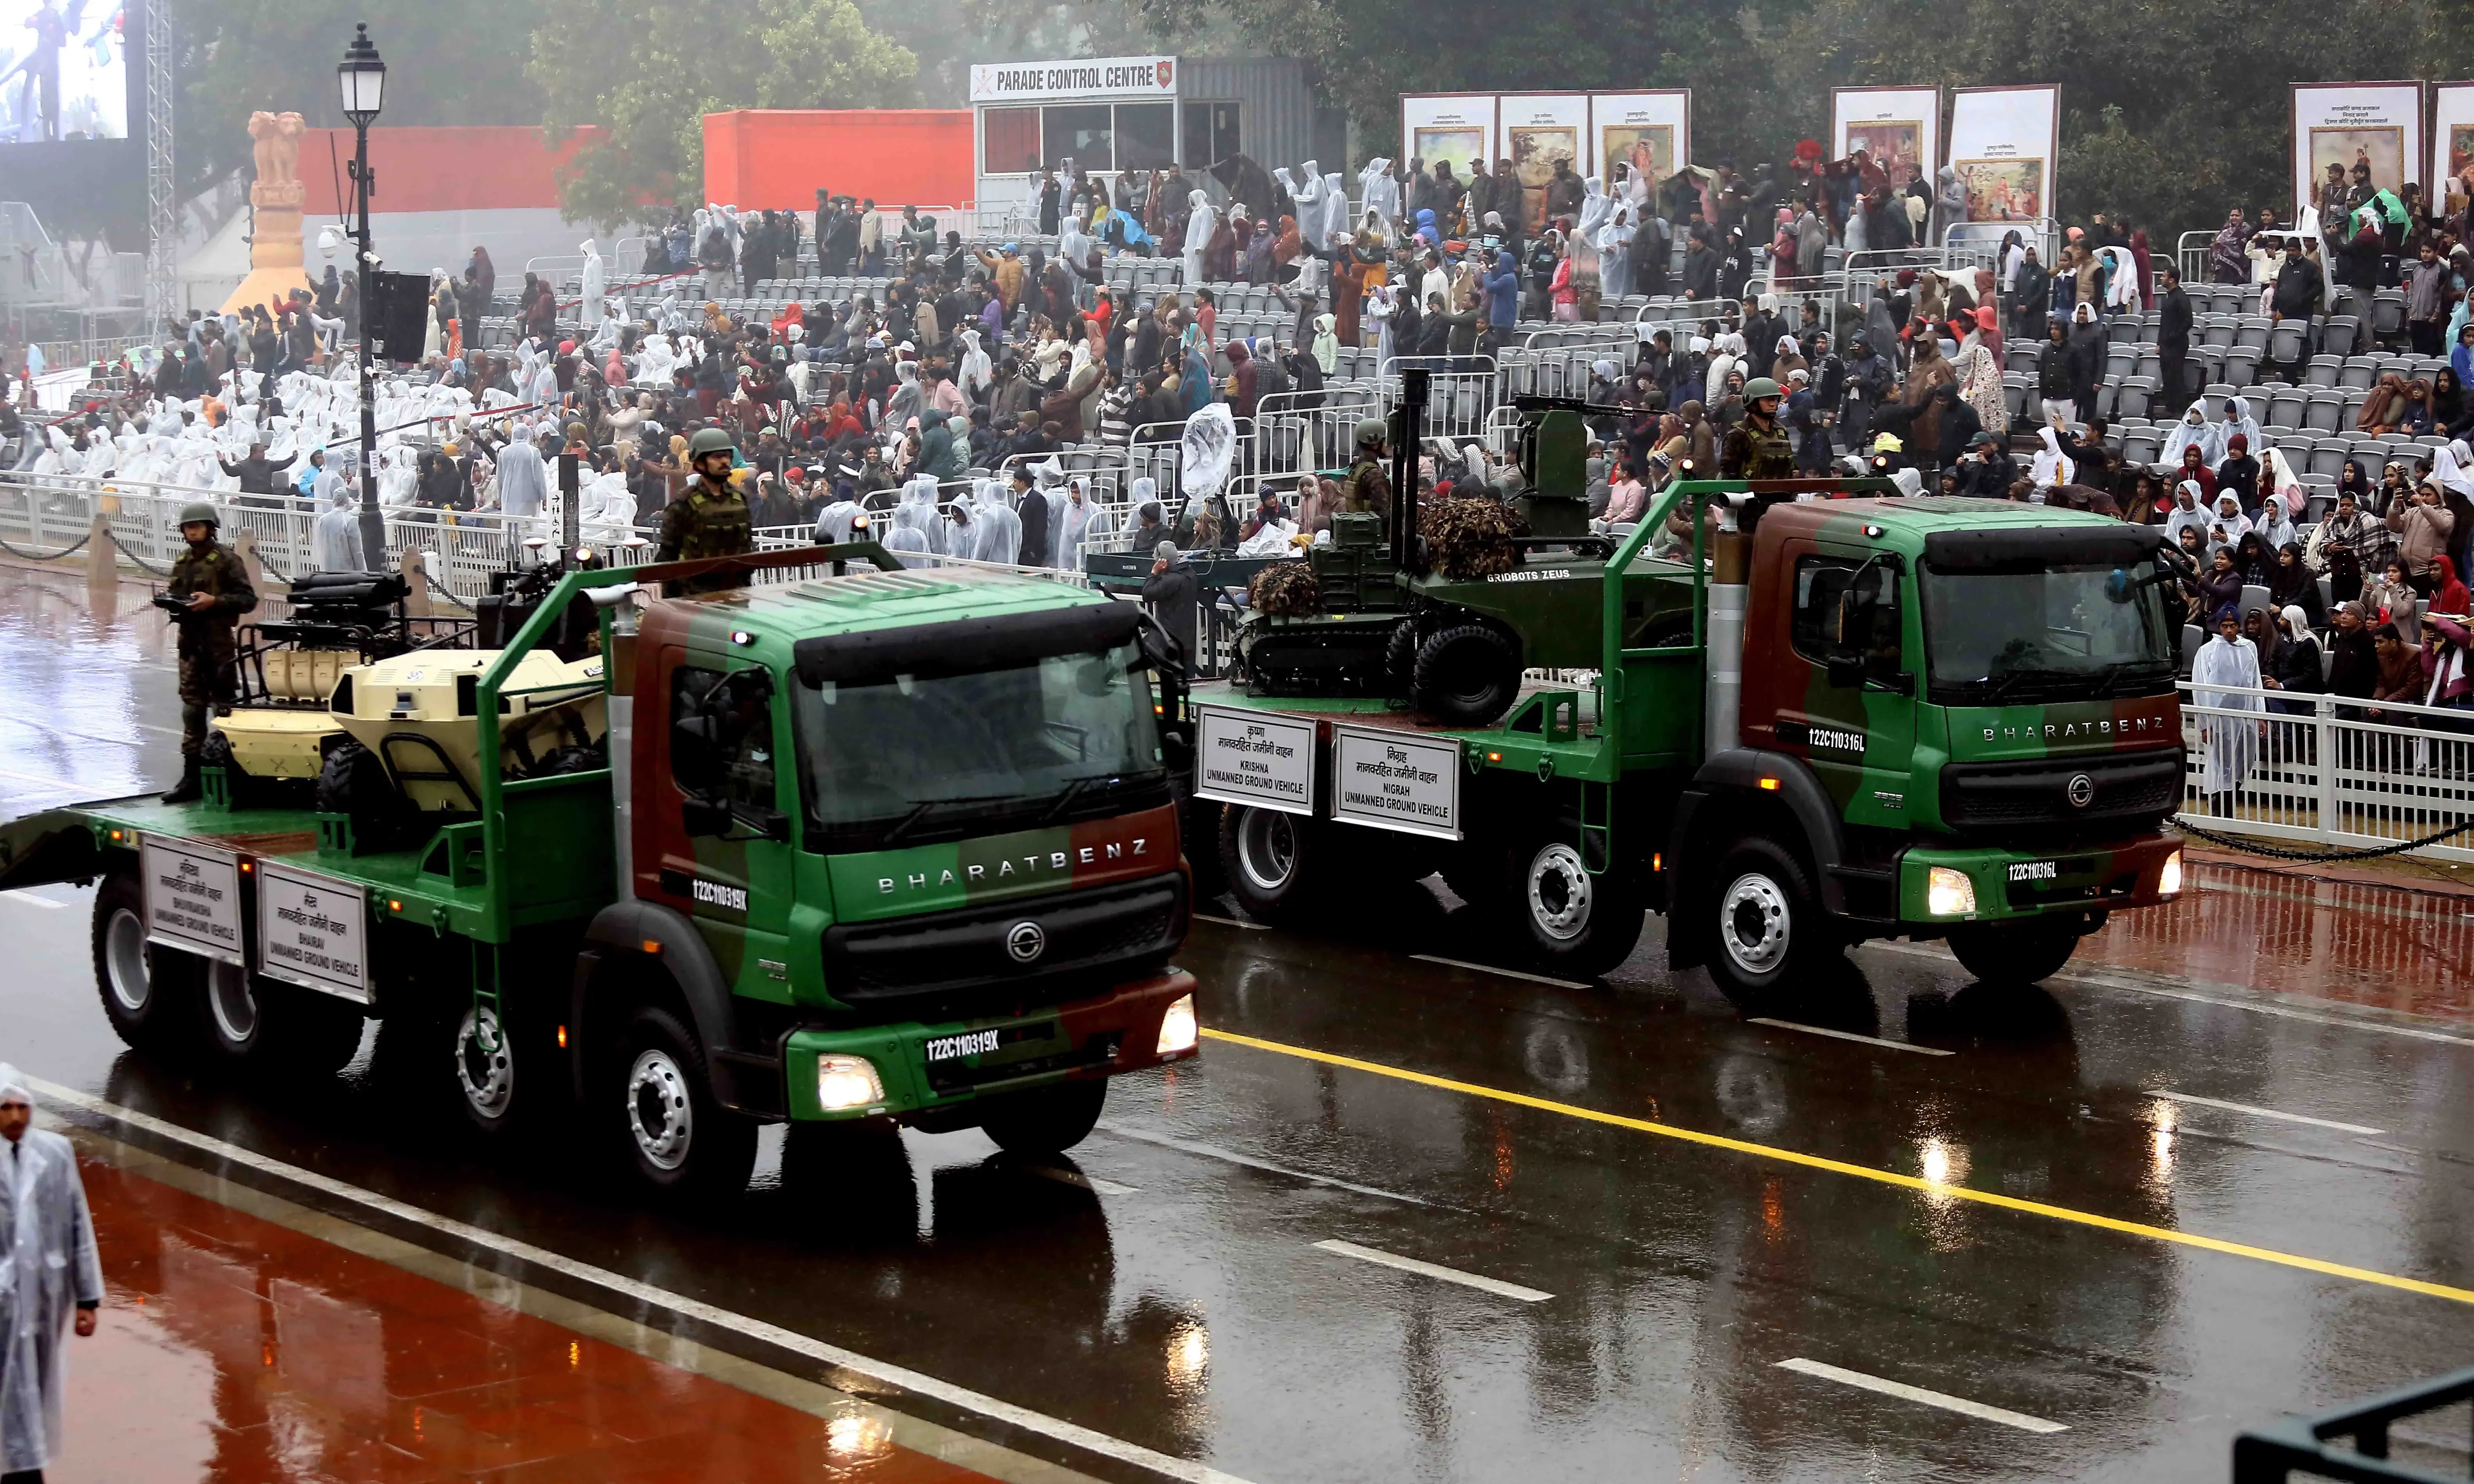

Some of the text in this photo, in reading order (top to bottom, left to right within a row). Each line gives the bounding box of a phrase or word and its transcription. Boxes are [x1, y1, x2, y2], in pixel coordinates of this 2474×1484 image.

[997, 65, 1153, 91] PARADE CONTROL CENTRE
[1487, 570, 1570, 583] GRIDBOTS ZEUS
[1247, 725, 1265, 740] कृष्णा
[1984, 717, 2163, 741] BHARATBENZ
[1218, 737, 1293, 758] मानवरहित जमीनी वाहन
[1814, 729, 1864, 752] 22C110316L
[1387, 747, 1407, 763] निग्रह
[1240, 760, 1268, 774] KRISHNA
[1356, 762, 1437, 784] मानवरहित जमीनी वाहन
[1207, 769, 1303, 794] UNMANNED GROUND VEHICLE
[1383, 783, 1410, 797] NIGRAH
[1345, 791, 1448, 818] UNMANNED GROUND VEHICLE
[879, 838, 1146, 894] BHARATBENZ
[2014, 861, 2056, 880] 22C110316L
[211, 923, 235, 940] VEHICLE
[299, 932, 325, 950] BHAIRAV
[270, 941, 359, 977] UNMANNED GROUND VEHICLE
[935, 1030, 999, 1058] 22C110319X
